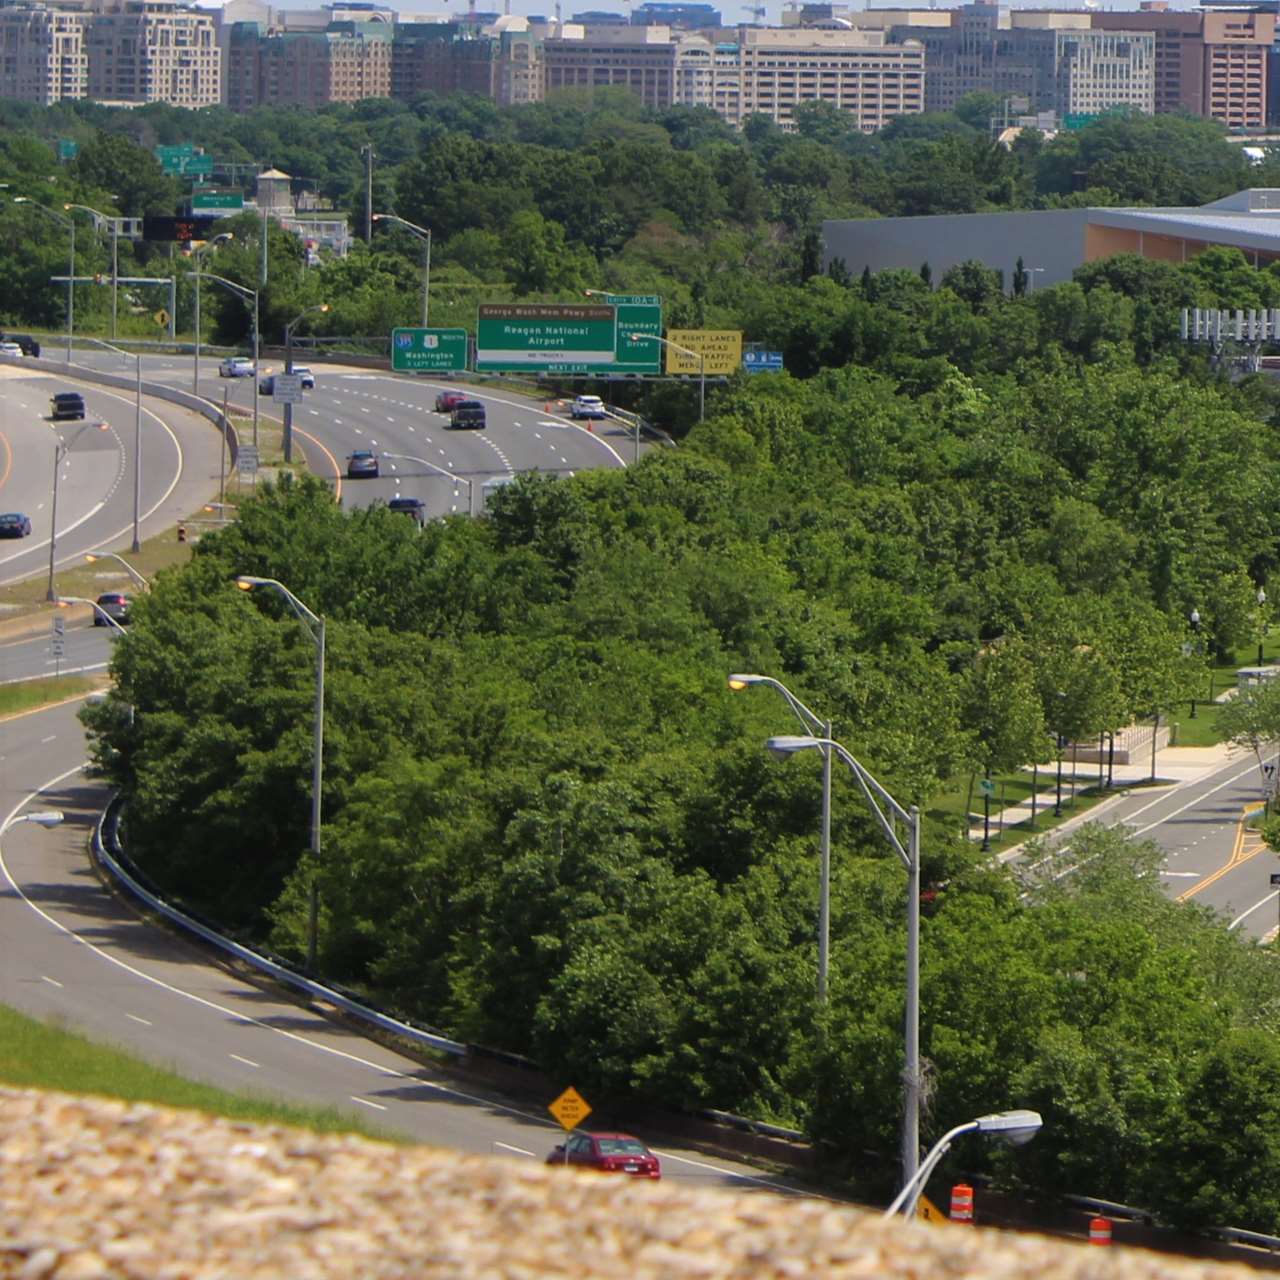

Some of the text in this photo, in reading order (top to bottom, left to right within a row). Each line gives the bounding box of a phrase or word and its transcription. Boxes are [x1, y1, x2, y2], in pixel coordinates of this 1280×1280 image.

[483, 308, 512, 317] George
[617, 321, 658, 330] Boundary
[503, 325, 589, 336] Reagan National
[527, 337, 565, 347] Airport
[709, 335, 736, 343] LANES
[701, 344, 728, 352] AHEAD
[404, 351, 455, 361] Washington
[413, 360, 429, 368] LEFT
[431, 360, 452, 368] LANES
